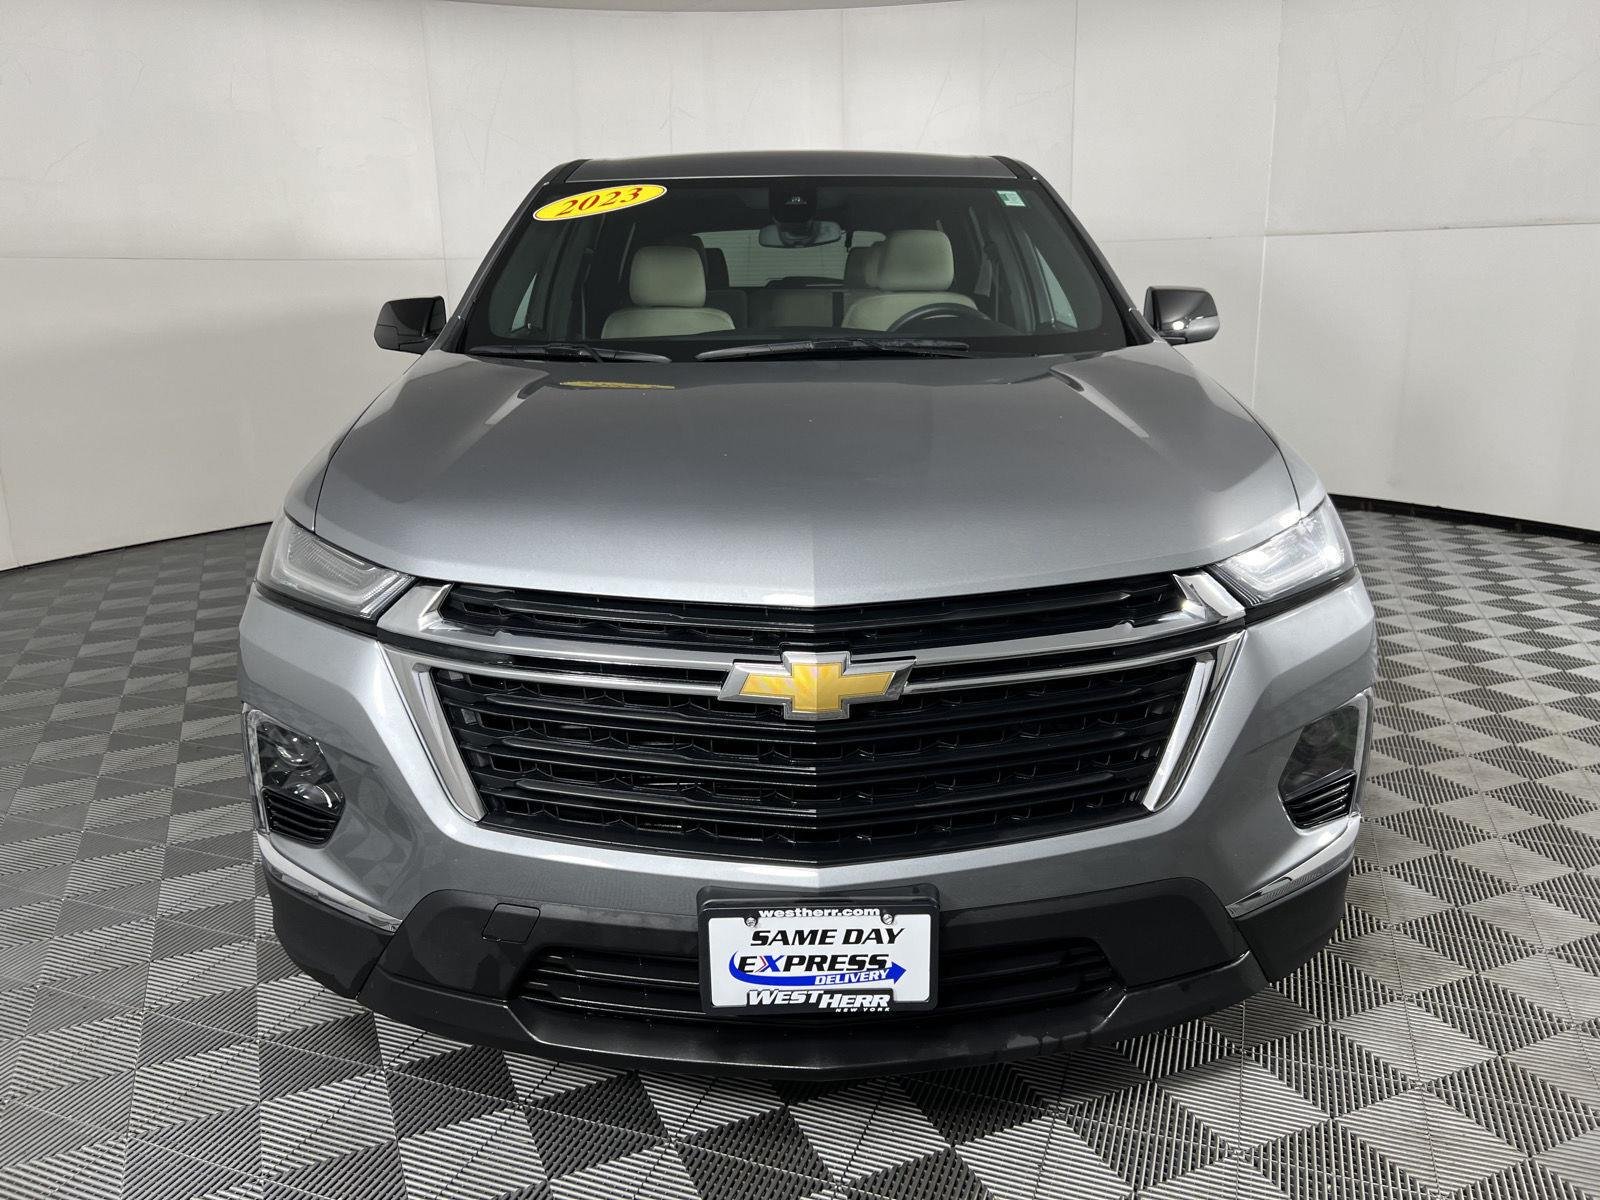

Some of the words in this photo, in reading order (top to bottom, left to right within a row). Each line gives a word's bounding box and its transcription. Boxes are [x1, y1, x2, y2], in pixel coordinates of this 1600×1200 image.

[555, 187, 642, 217] 2023
[758, 908, 880, 918] westherr.com
[750, 929, 837, 947] SAME
[842, 928, 905, 945] DAY
[737, 954, 889, 973] EXPRESS
[814, 970, 889, 986] DELIVERY
